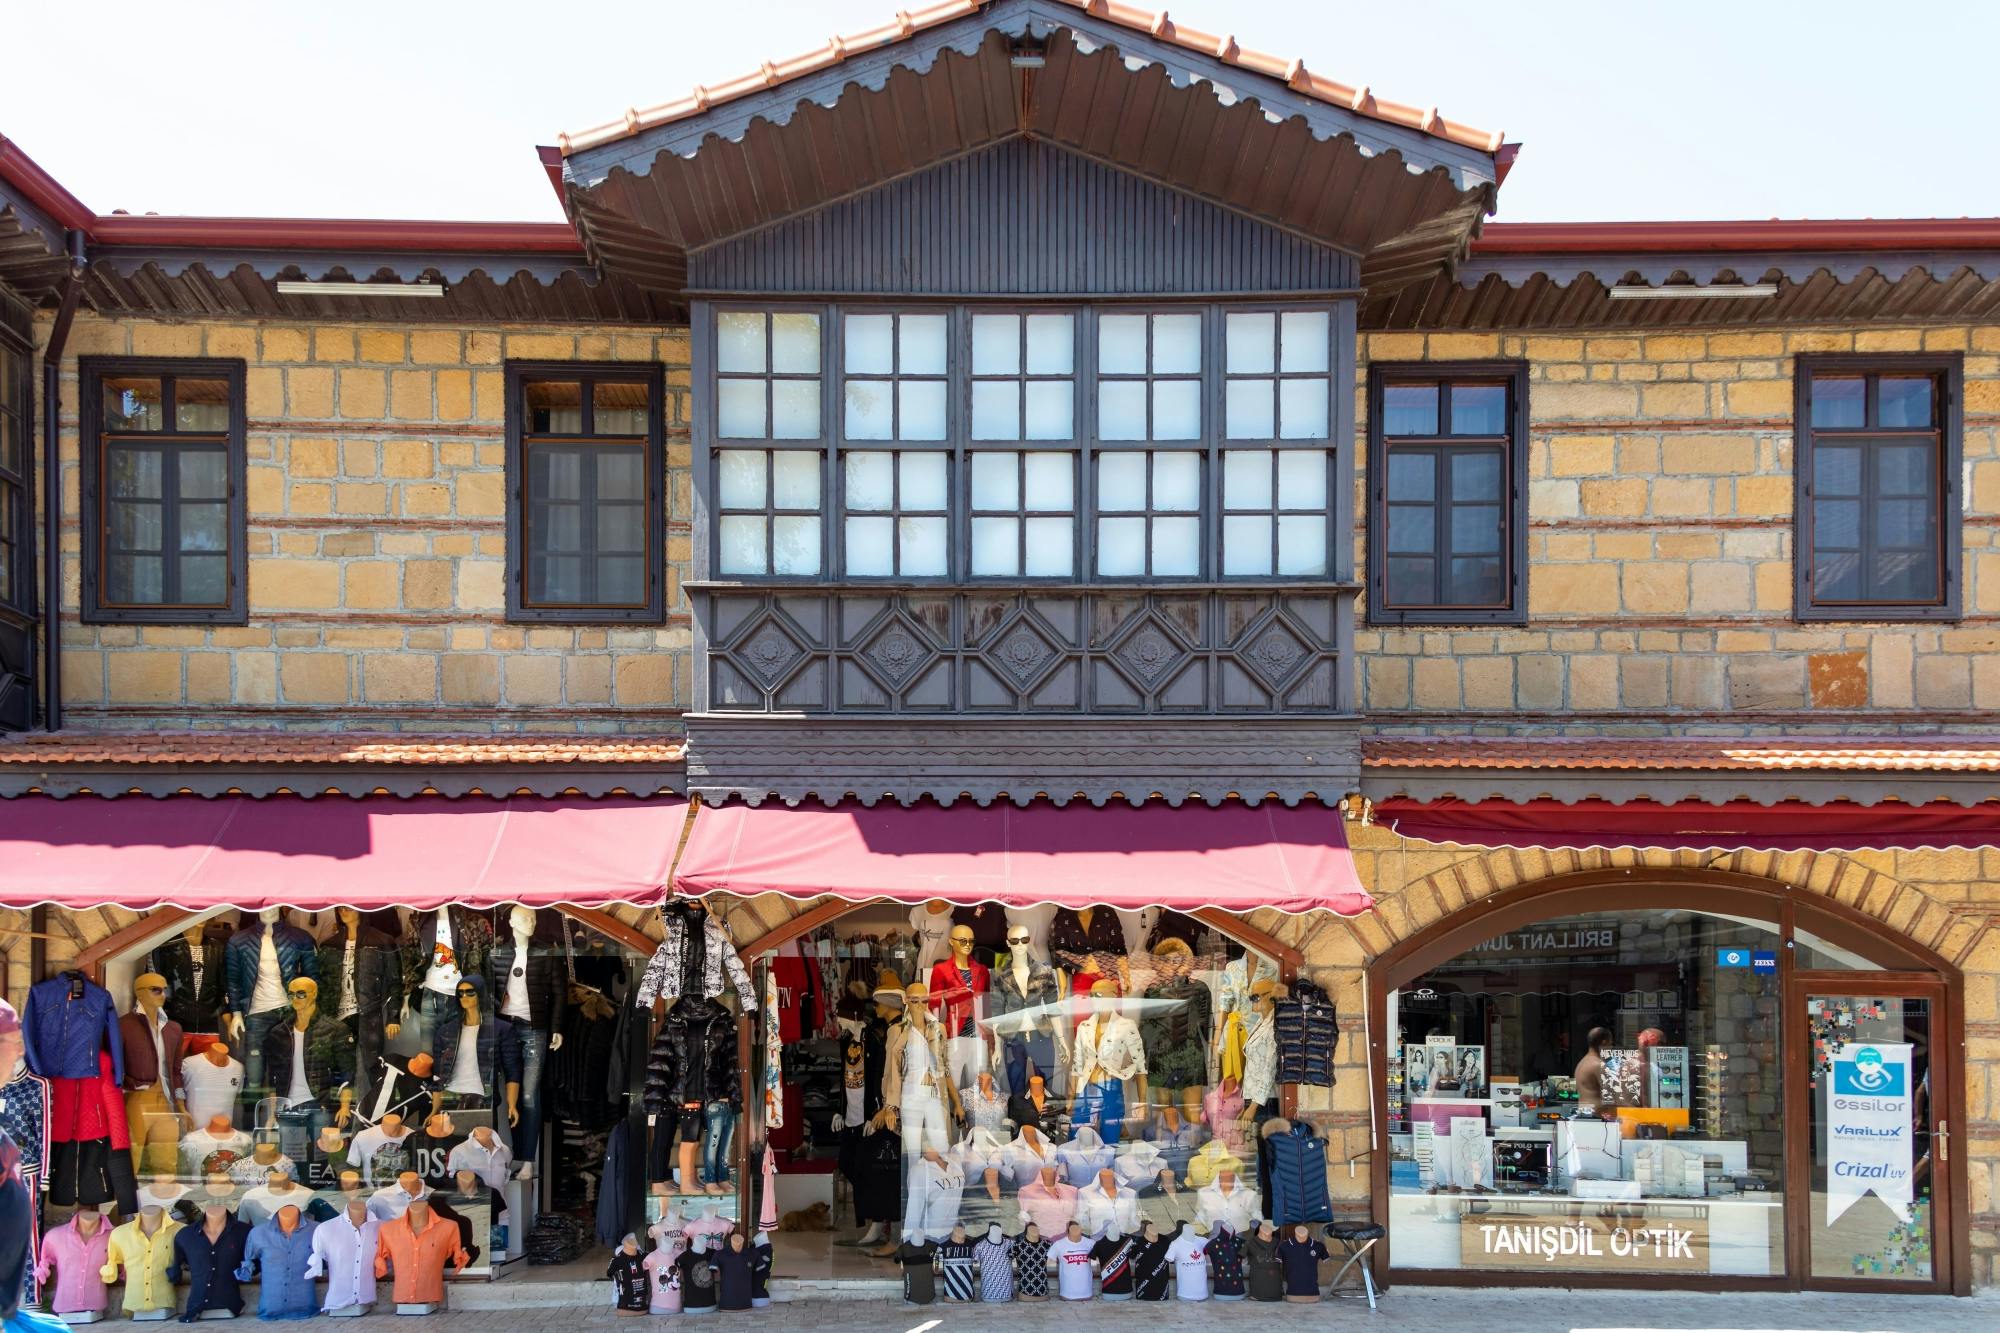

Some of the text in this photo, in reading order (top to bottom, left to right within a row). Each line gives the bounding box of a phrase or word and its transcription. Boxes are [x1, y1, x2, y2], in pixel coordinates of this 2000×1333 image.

[1834, 1098, 1906, 1112] essilor
[309, 1163, 335, 1179] EA
[1834, 1161, 1889, 1178] Crizal
[1479, 1220, 1695, 1261] TANIŞDİL OPTİK
